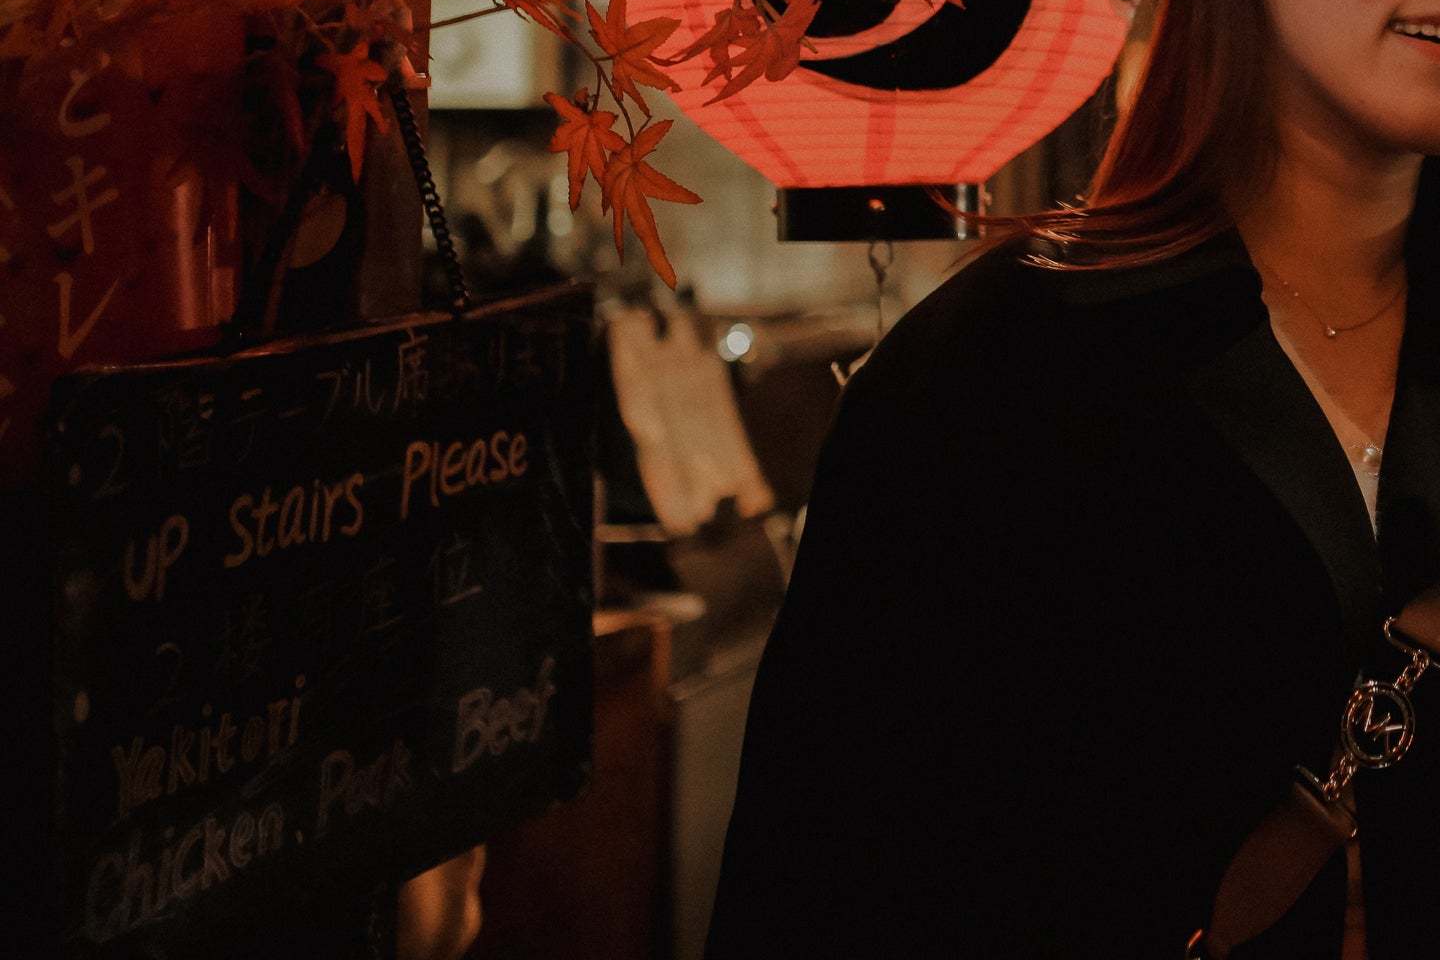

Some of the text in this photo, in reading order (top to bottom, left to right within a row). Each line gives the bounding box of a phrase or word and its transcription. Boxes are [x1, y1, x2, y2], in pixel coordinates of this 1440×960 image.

[222, 472, 366, 570] Stairs
[400, 427, 529, 521] Please
[110, 673, 308, 823] Yakitori
[451, 656, 557, 774] Beef
